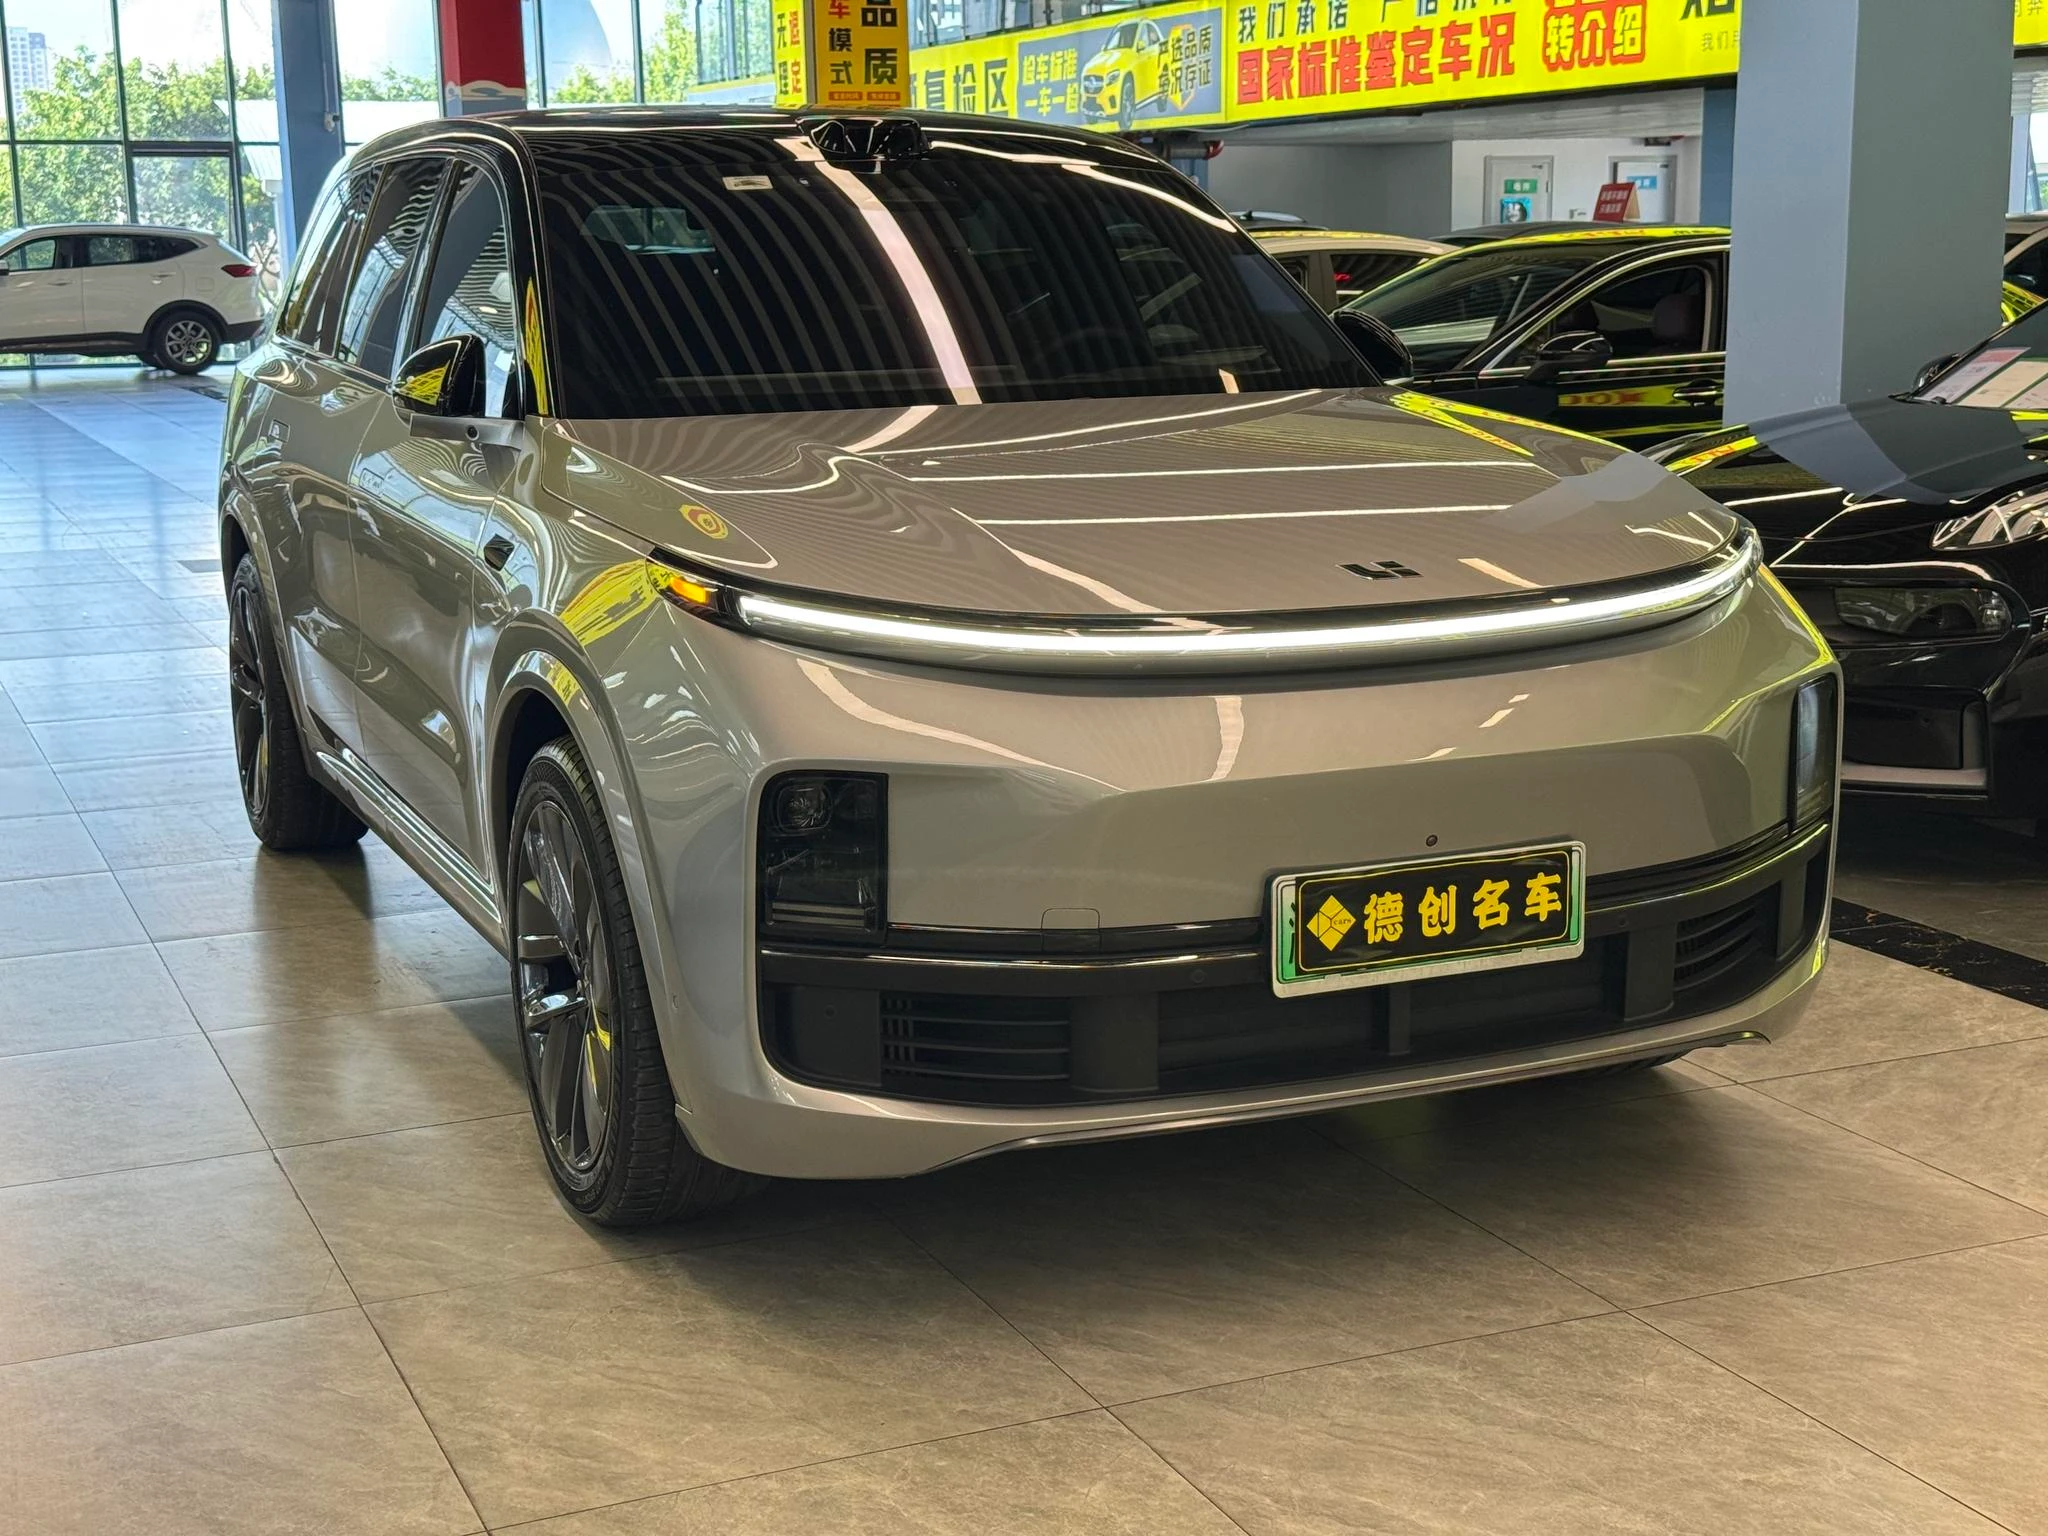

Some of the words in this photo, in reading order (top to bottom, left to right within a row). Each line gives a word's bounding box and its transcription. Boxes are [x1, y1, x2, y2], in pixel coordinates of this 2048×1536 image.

[861, 0, 898, 84] 品质
[1238, 0, 1348, 43] 我们承诺
[1546, 6, 1643, 63] 转介绍
[911, 58, 1008, 115] 复检区
[1236, 12, 1516, 105] 国家标准鉴定车况
[1363, 872, 1562, 945] 德创名车
